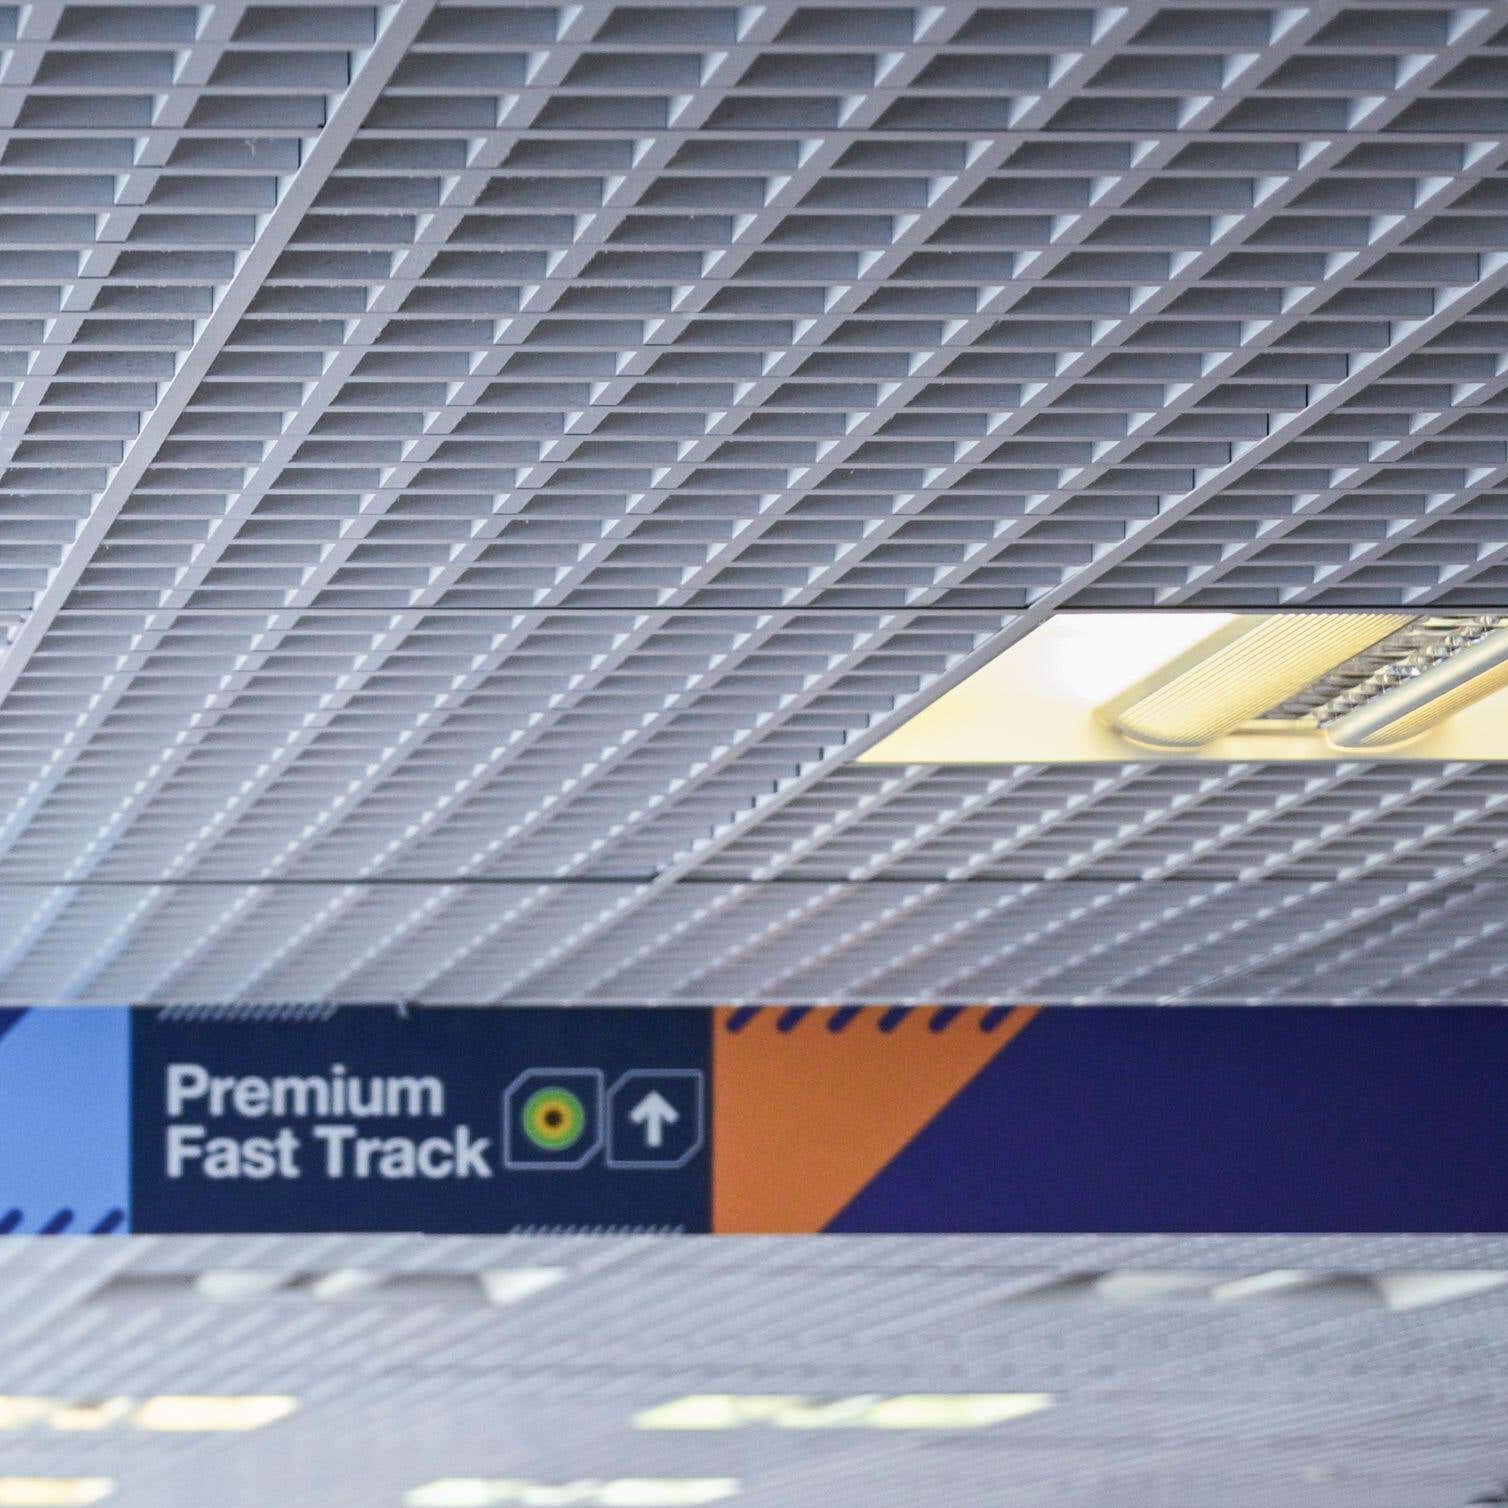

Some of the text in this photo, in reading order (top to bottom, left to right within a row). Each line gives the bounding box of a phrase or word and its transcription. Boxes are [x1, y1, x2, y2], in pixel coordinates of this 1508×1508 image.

[166, 1063, 444, 1117] Premium
[166, 1124, 492, 1178] Fast Track
